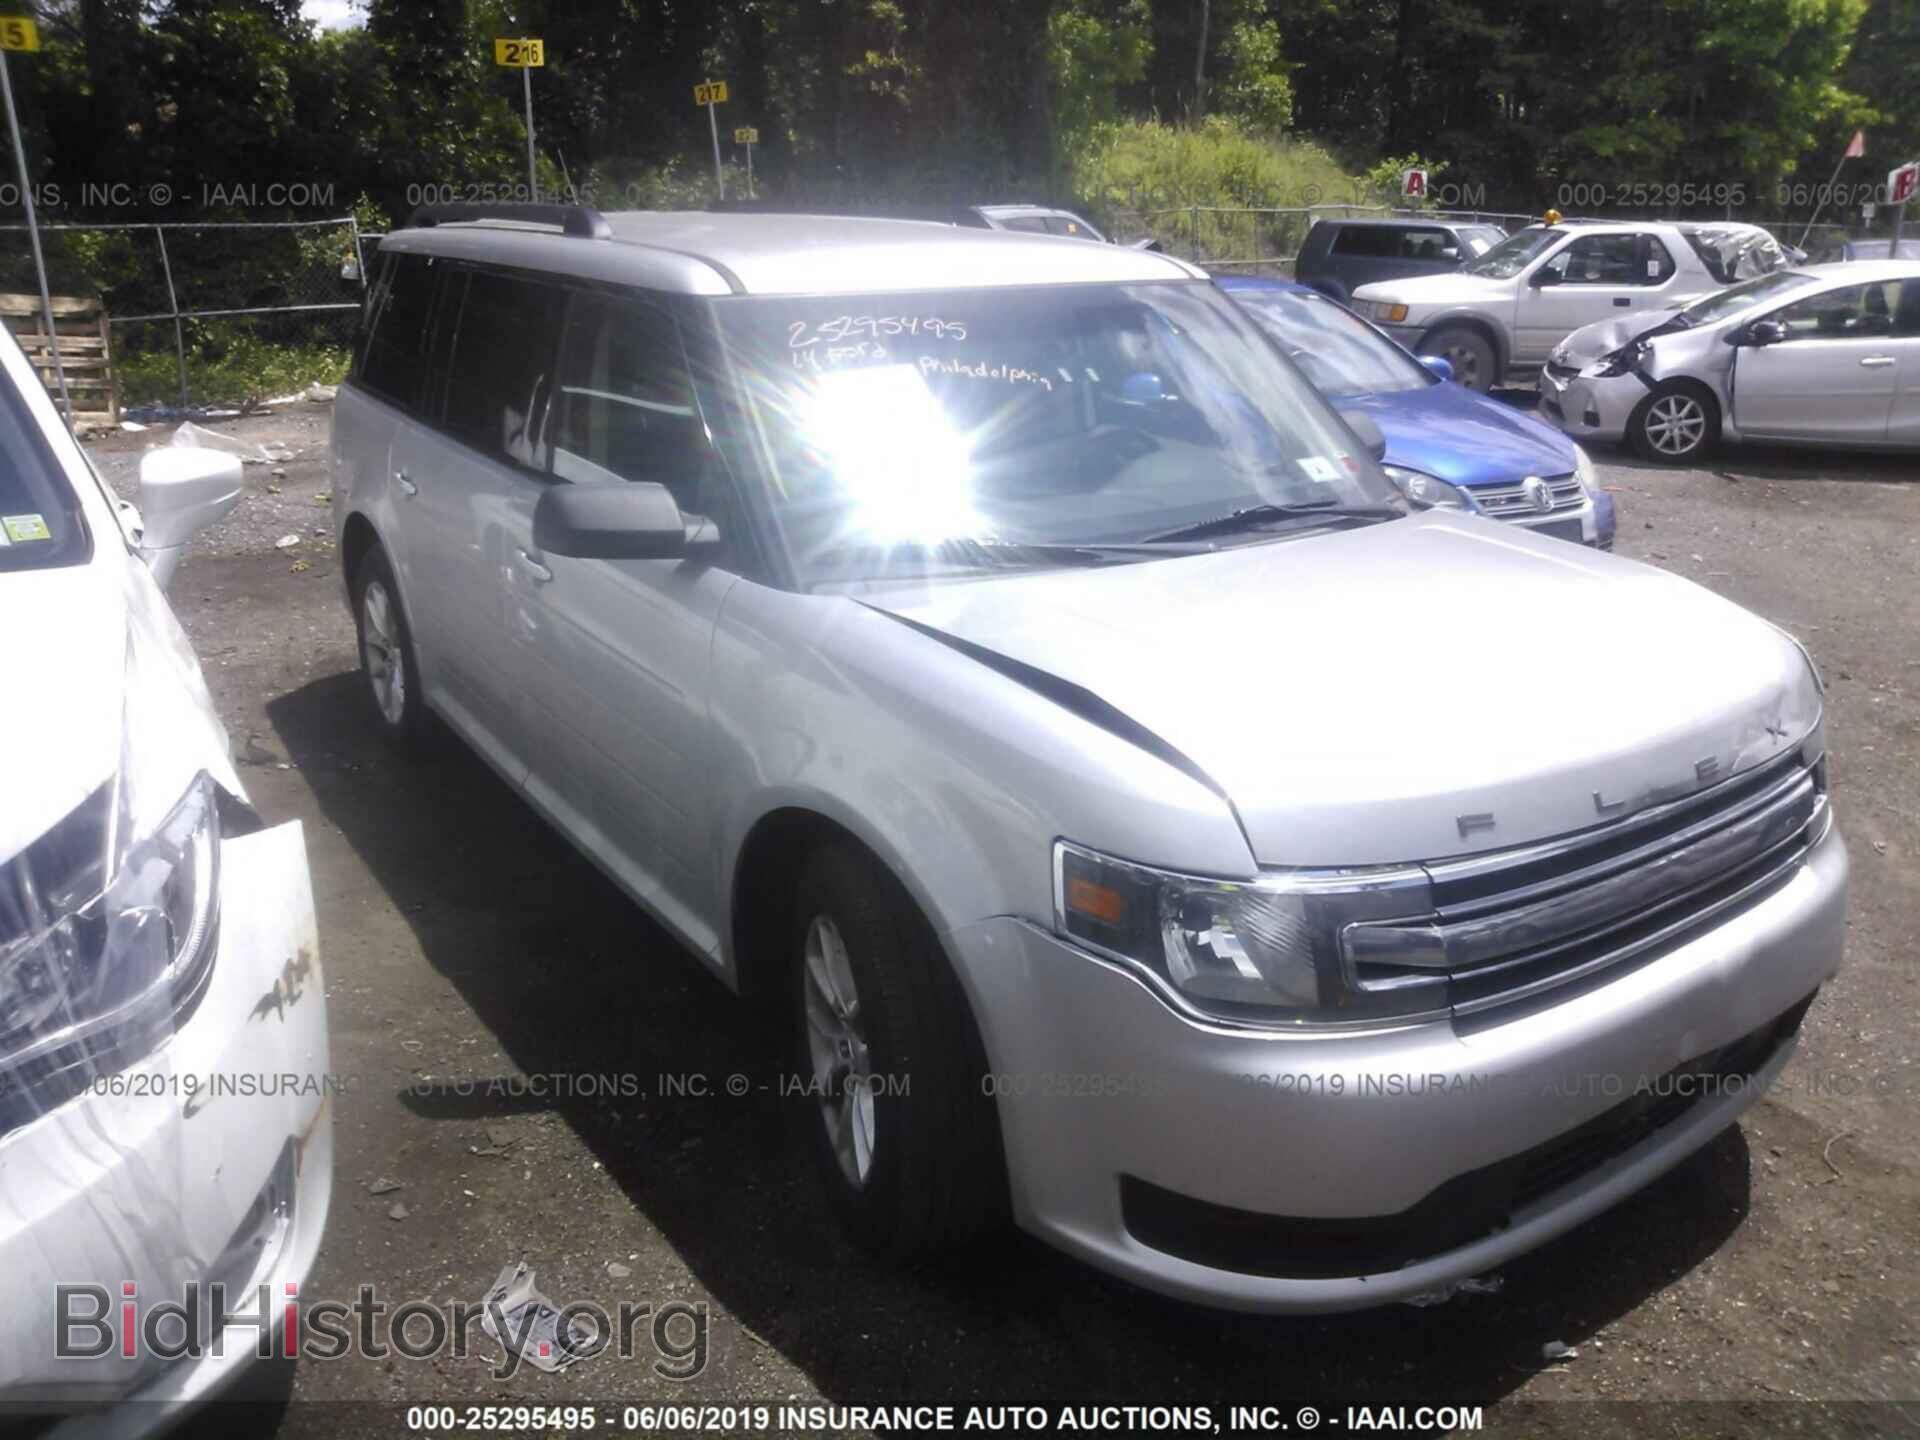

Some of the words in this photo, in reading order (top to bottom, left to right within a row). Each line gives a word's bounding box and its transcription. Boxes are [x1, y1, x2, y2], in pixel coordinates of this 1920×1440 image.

[8, 23, 25, 46] 5
[505, 43, 539, 63] 216
[1407, 172, 1424, 196] A
[787, 316, 967, 348] 25295495
